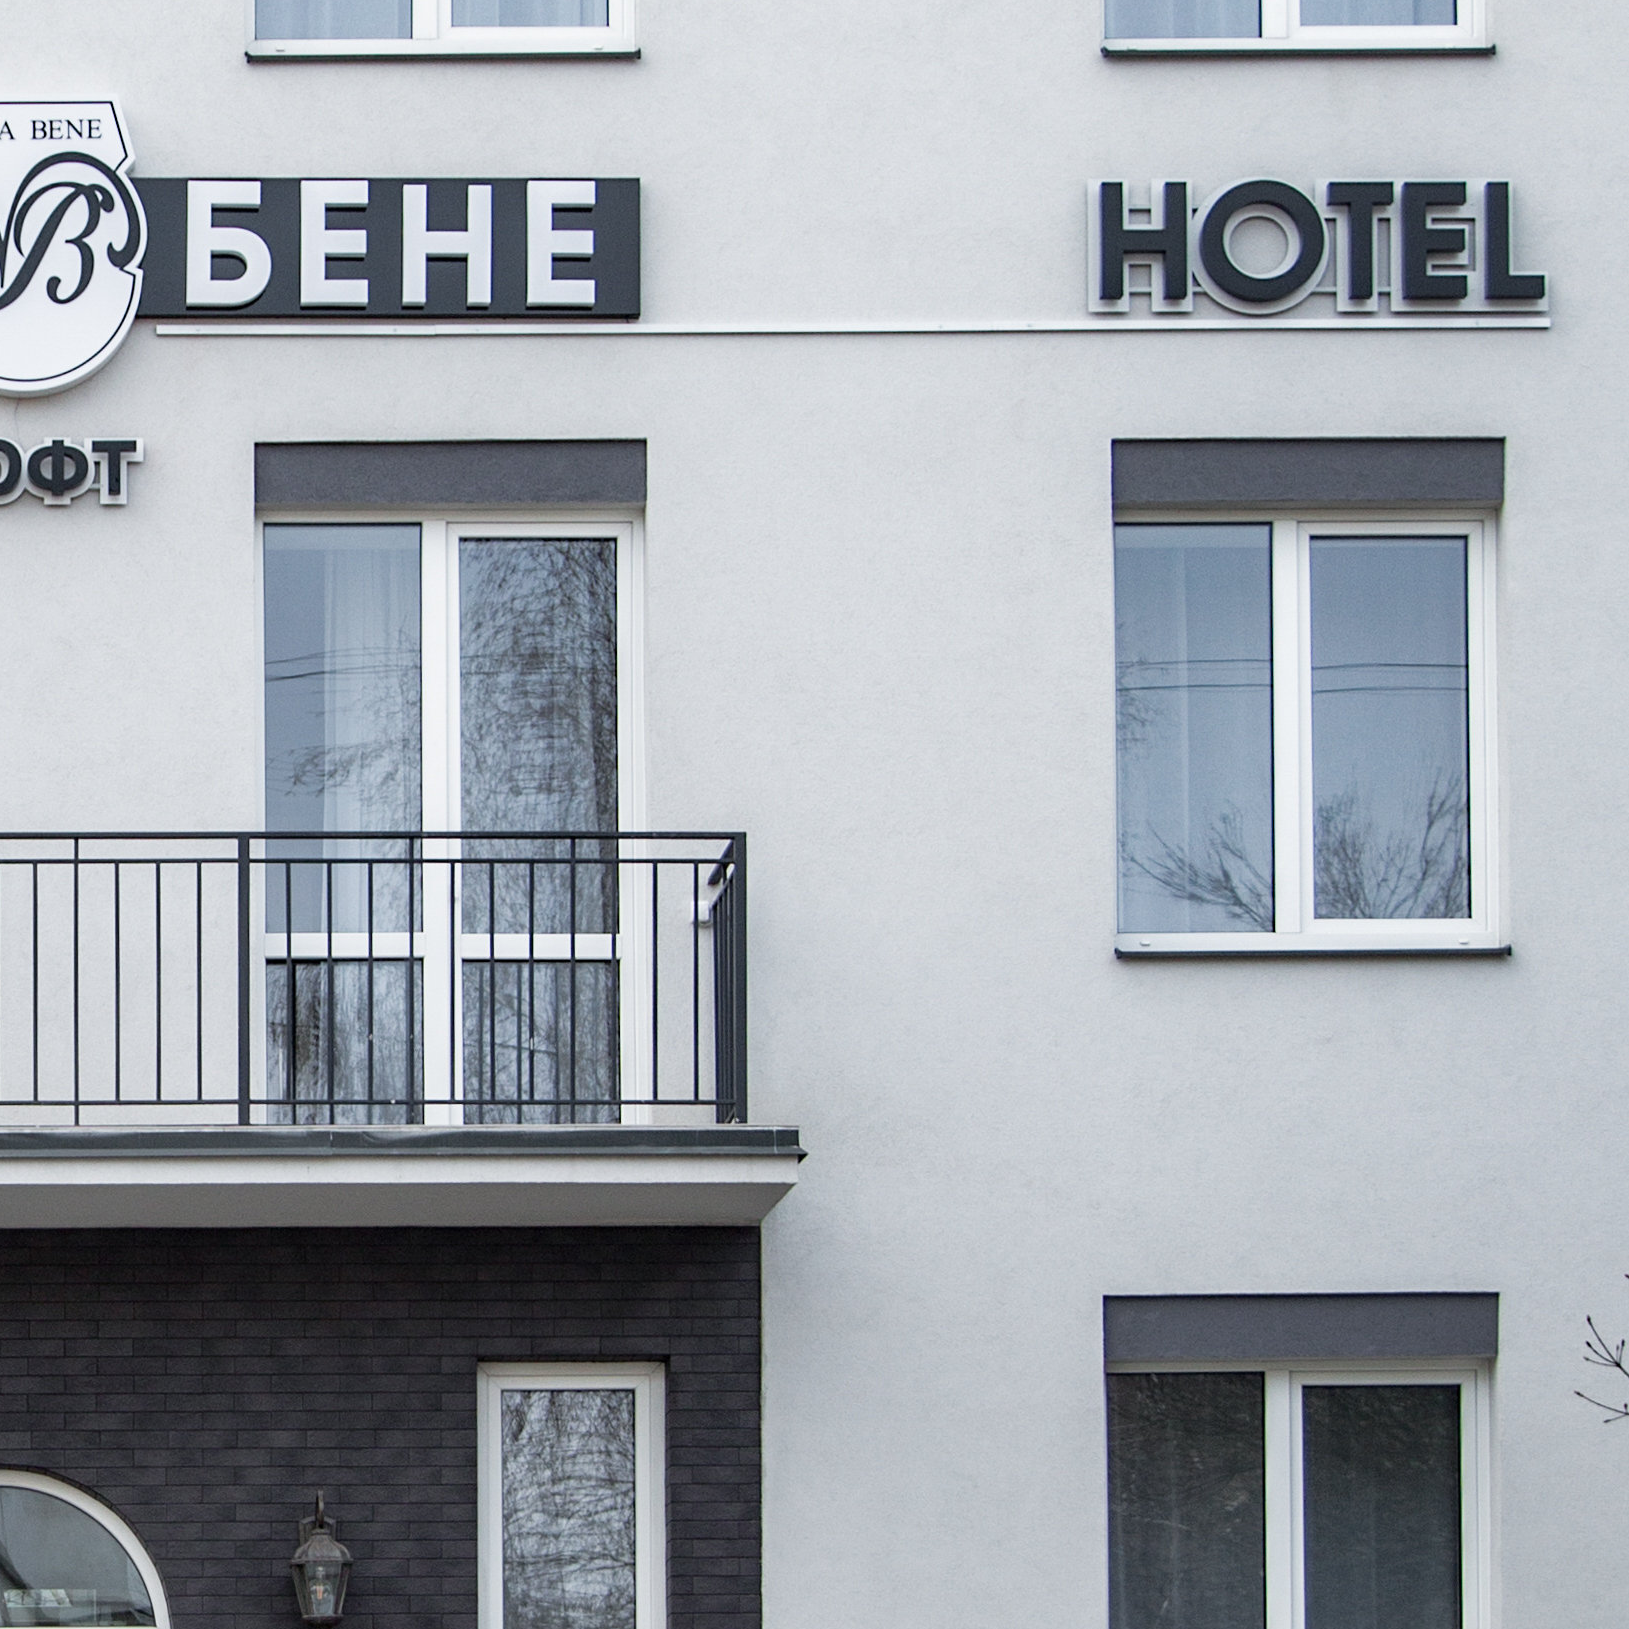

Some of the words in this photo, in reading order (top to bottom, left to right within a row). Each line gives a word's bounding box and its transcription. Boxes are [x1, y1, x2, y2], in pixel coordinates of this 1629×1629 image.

[30, 118, 102, 141] BENE
[185, 179, 597, 310] БЕНЕ
[1098, 178, 1547, 304] HOTEL
